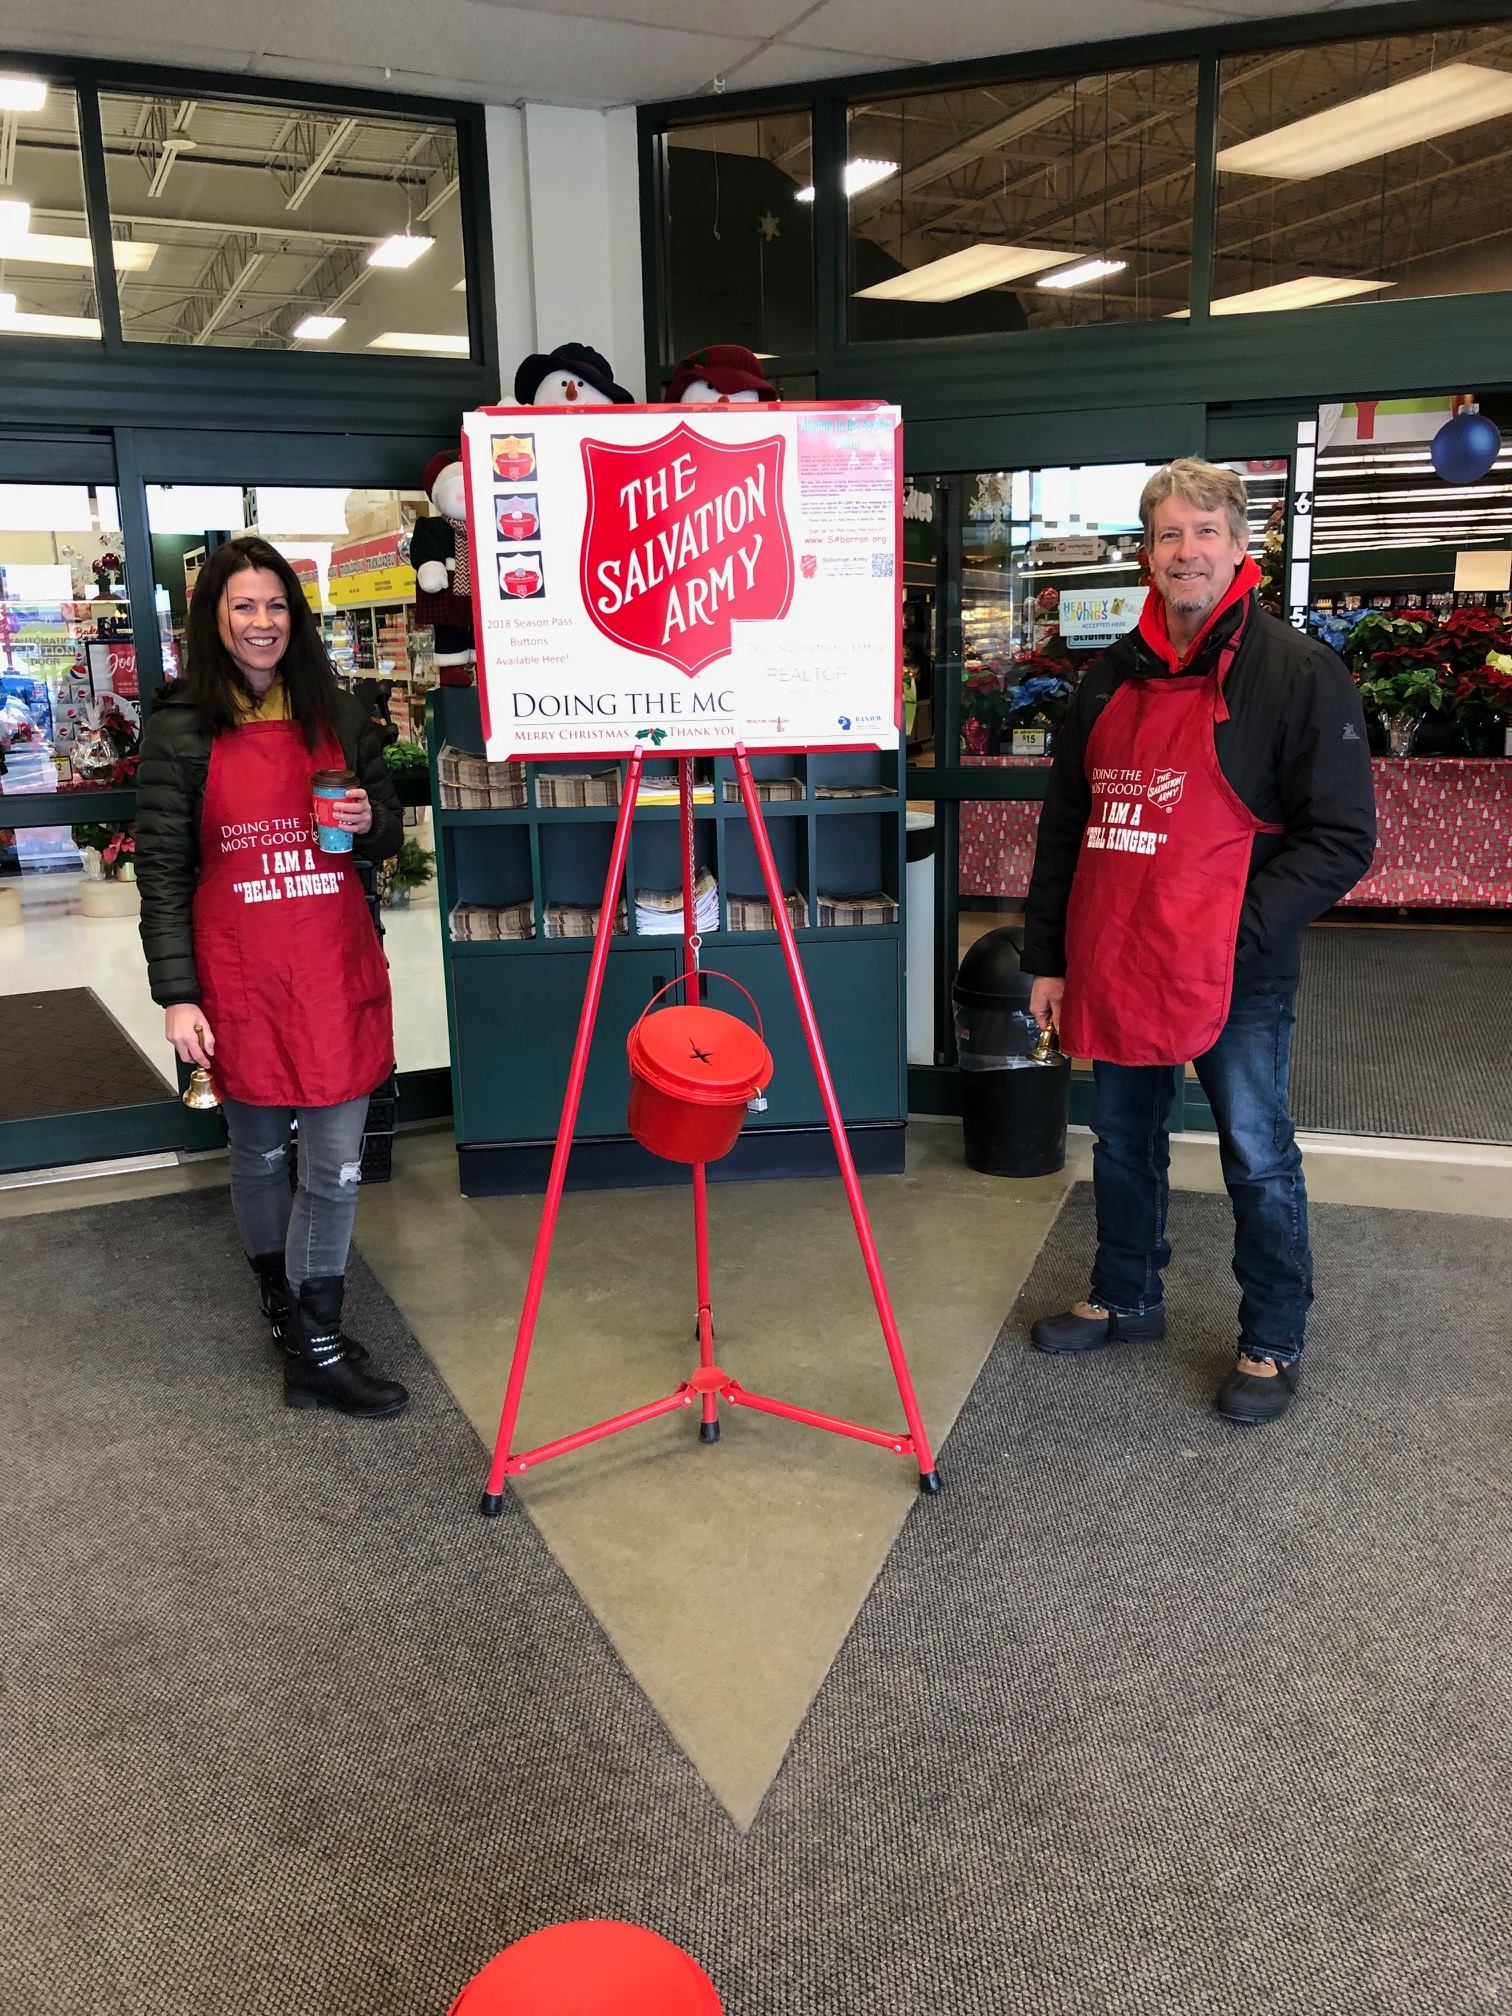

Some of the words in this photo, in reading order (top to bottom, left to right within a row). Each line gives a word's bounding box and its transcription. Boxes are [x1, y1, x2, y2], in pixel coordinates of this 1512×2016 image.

[619, 452, 698, 532] THE
[1294, 492, 1312, 514] 6
[597, 463, 767, 614] SALVATION
[661, 533, 763, 646] ARMY
[1063, 600, 1108, 613] HEALTHY
[487, 619, 511, 629] 2018
[513, 618, 549, 628] Season
[552, 617, 573, 626] Pass
[1063, 611, 1108, 621] SAVINGS
[1289, 606, 1307, 629] 5
[14, 637, 70, 645] AUTOMATIC
[510, 637, 548, 647] Buttons
[31, 658, 60, 666] DOOR
[495, 655, 540, 665] Available
[542, 654, 569, 663] Here!
[512, 692, 617, 718] DOING
[625, 692, 682, 714] THE
[514, 730, 555, 741] MERRY
[559, 728, 630, 740] CHRISTMAS
[668, 726, 710, 737] THANK
[715, 726, 735, 736] YO
[1022, 734, 1036, 744] $15
[1092, 767, 1119, 781] DOING
[1120, 769, 1143, 781] THE
[1156, 771, 1171, 784] THE
[1148, 775, 1182, 798] SALVATION
[1157, 786, 1179, 803] ARMY
[1102, 801, 1108, 823] I
[1108, 801, 1130, 825] AM
[1129, 803, 1143, 826] A
[221, 820, 269, 839] DOING
[272, 817, 300, 831] THE
[220, 835, 258, 853] MOST
[1106, 827, 1167, 855] RINGER"
[262, 853, 270, 875] I
[274, 849, 301, 874] AM
[304, 848, 316, 871] A
[233, 878, 282, 904] "BELL
[284, 871, 345, 899] RINGER"
